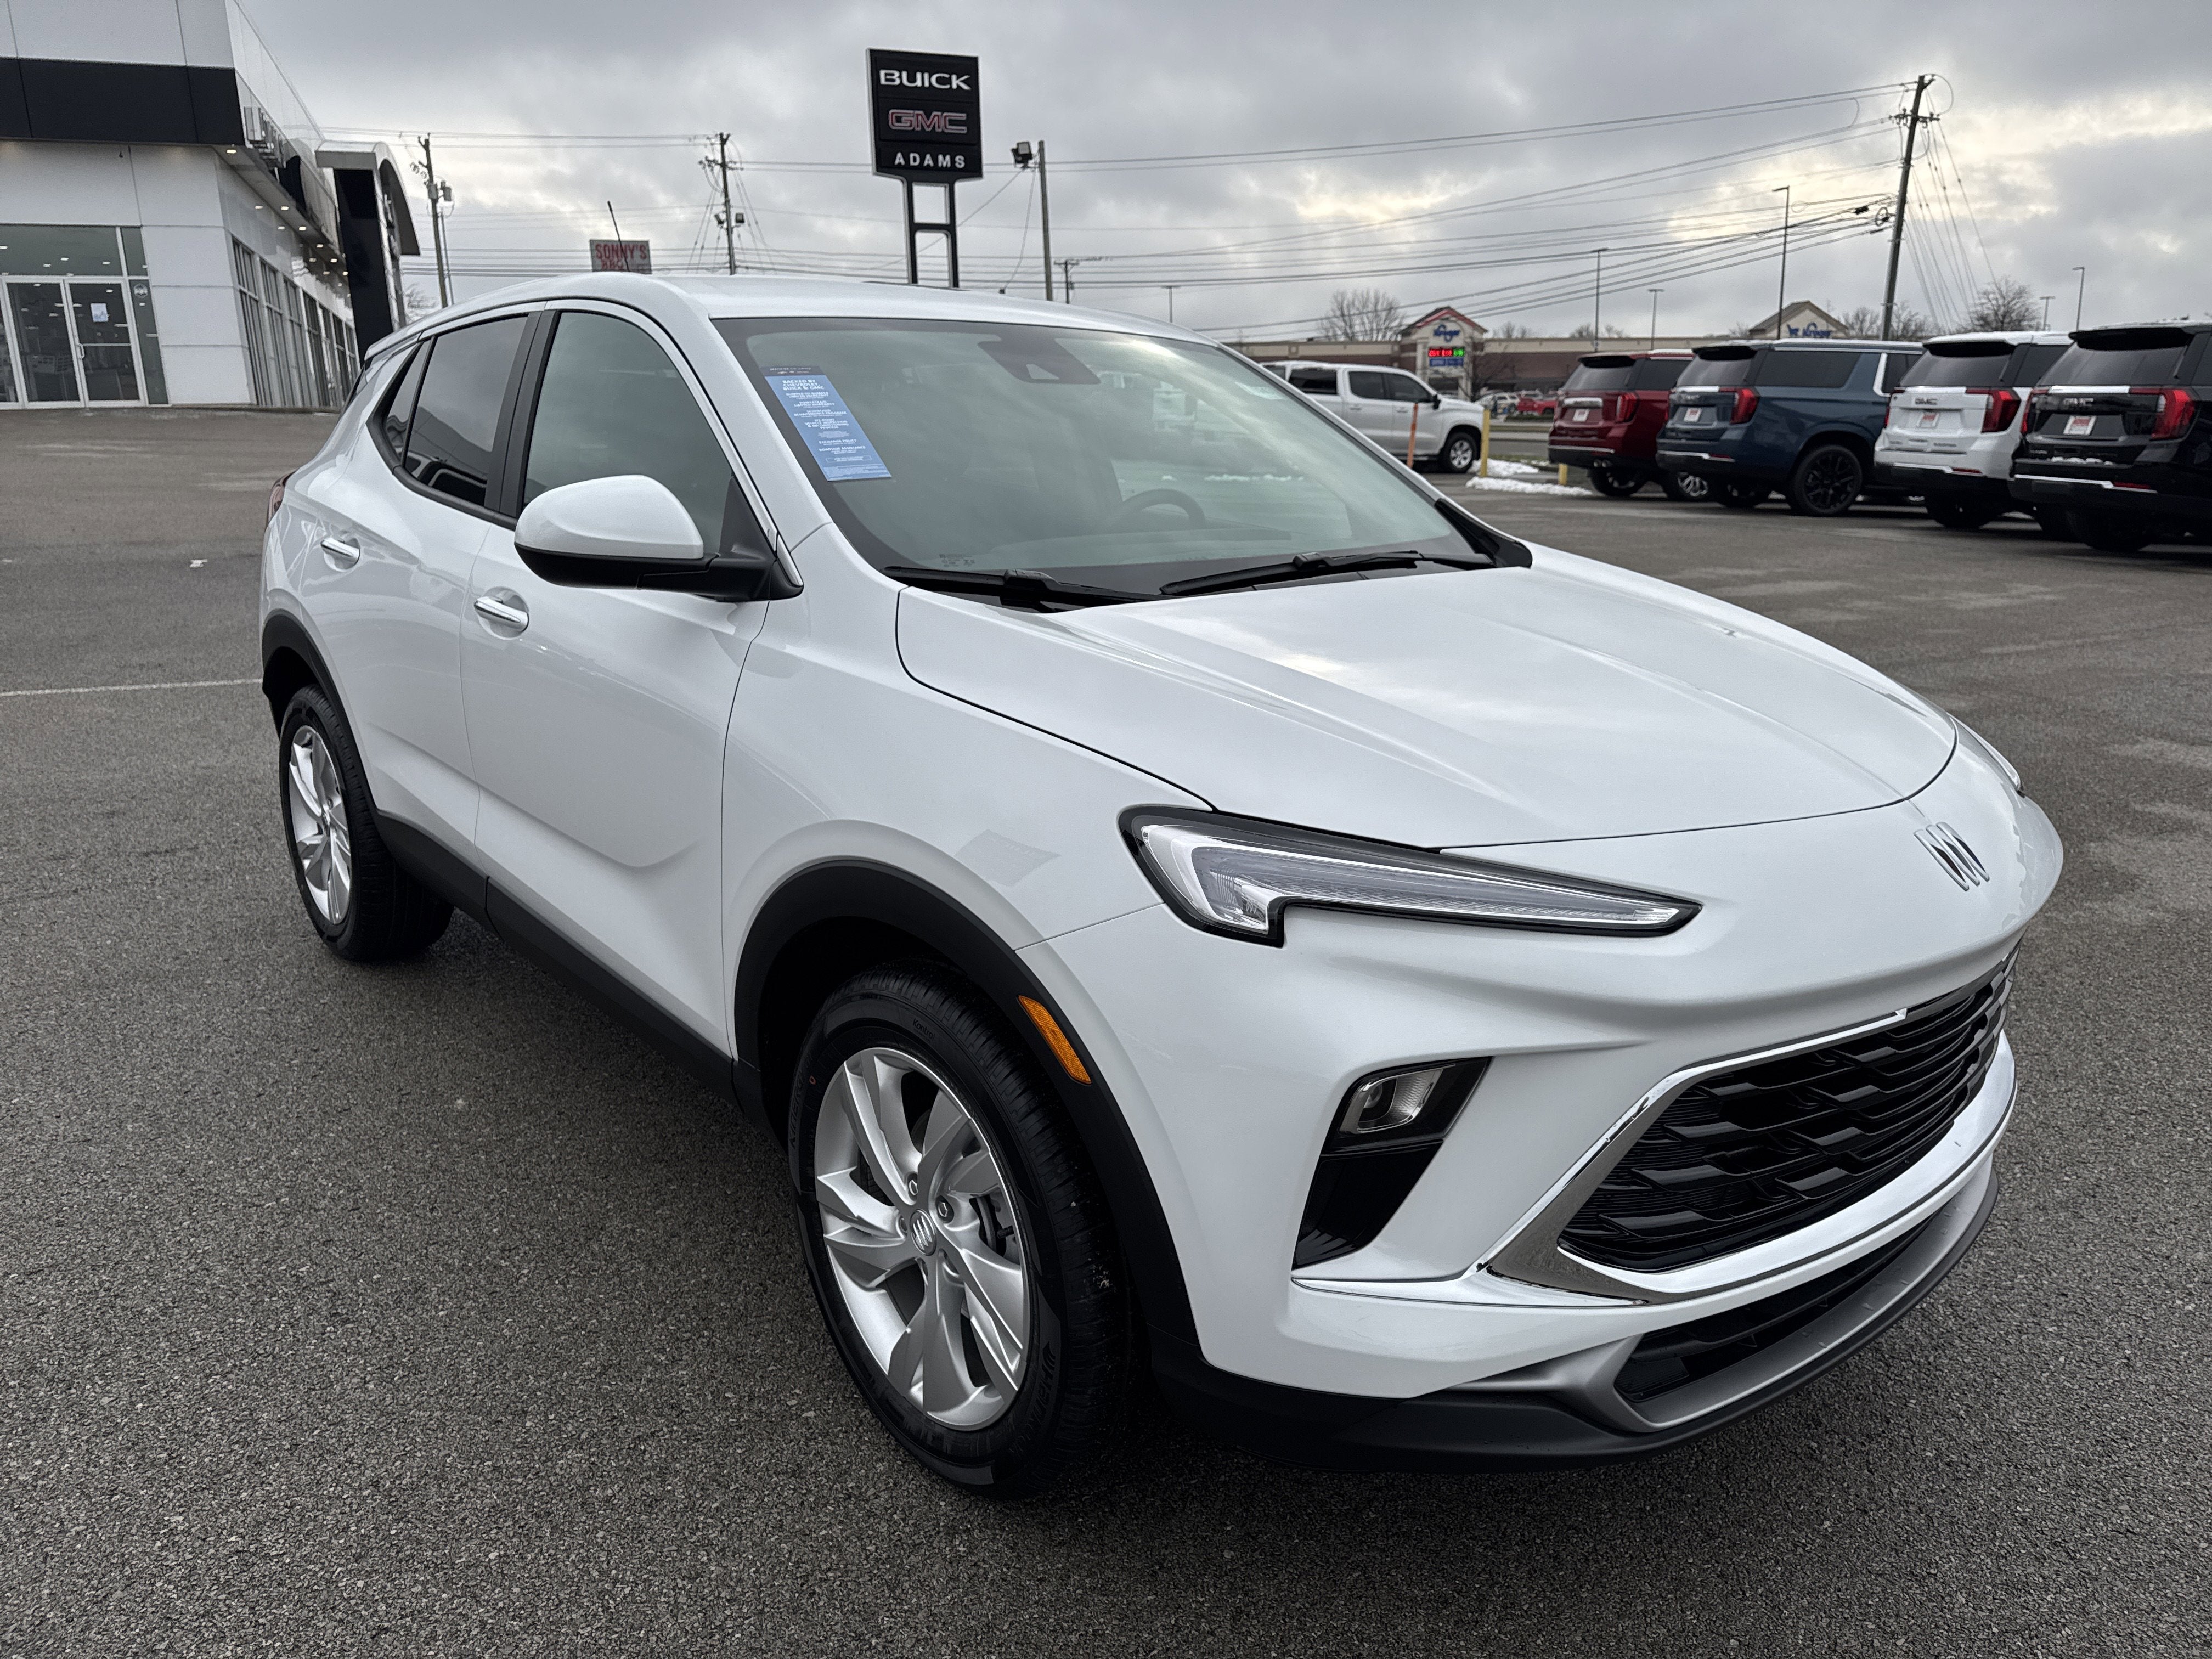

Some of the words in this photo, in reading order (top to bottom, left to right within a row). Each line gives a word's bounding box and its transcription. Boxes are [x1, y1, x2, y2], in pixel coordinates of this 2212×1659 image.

[879, 69, 971, 91] BUICK
[888, 109, 967, 133] GMC
[894, 152, 966, 168] ADAMS
[595, 244, 647, 259] SONNY'S
[912, 1018, 935, 1041] Kontrol
